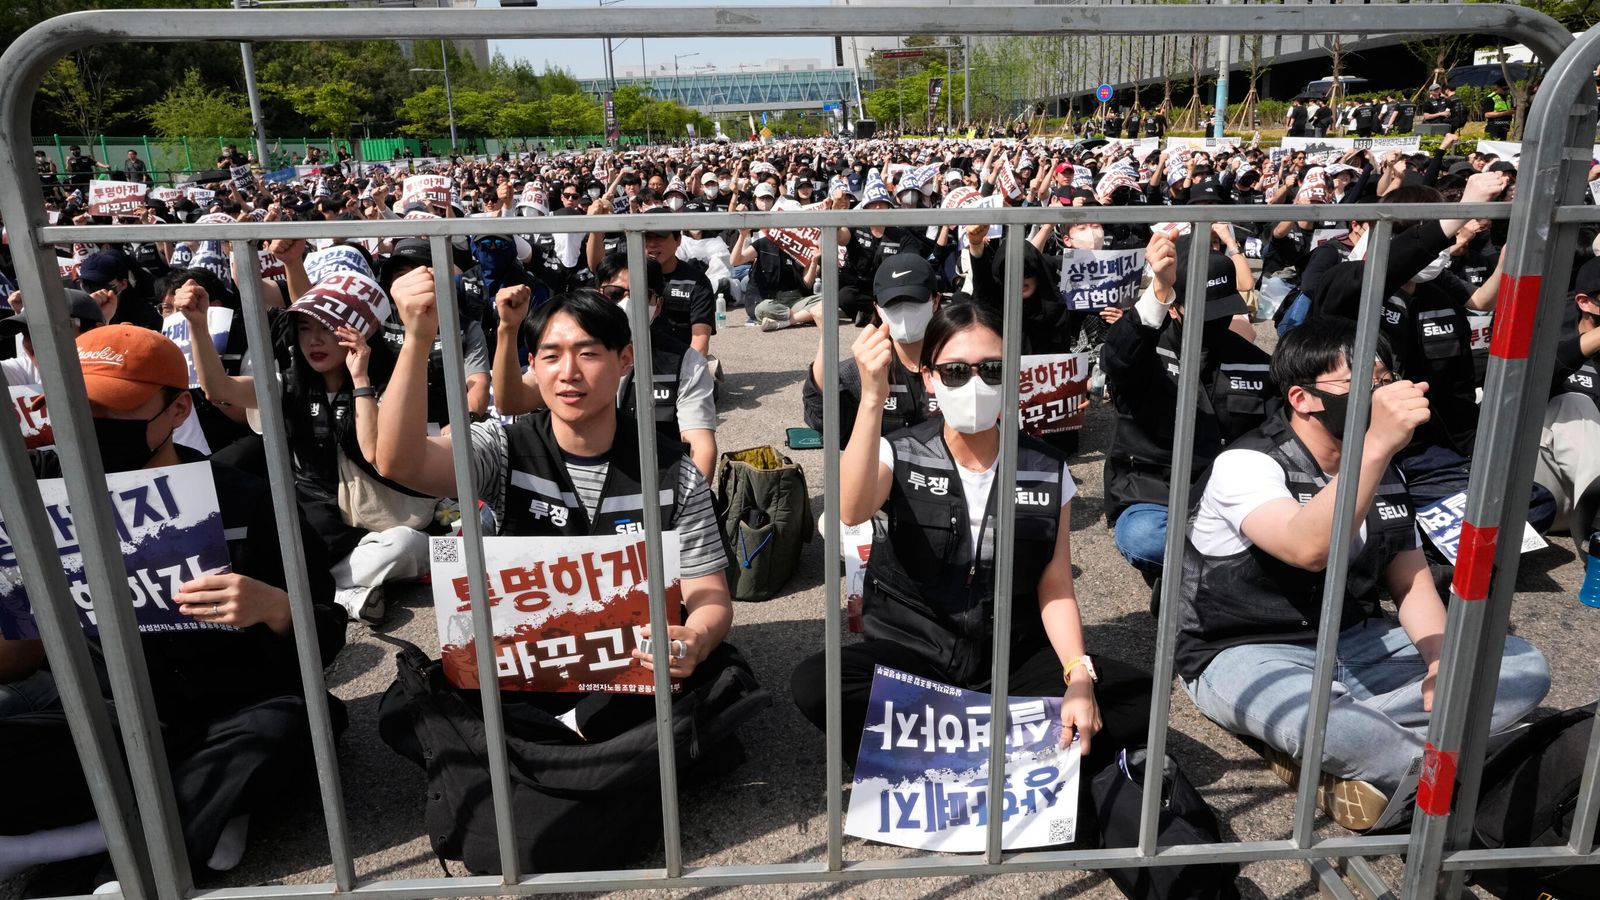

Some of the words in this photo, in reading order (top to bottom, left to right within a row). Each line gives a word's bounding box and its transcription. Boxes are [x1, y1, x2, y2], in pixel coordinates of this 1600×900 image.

[1354, 139, 1373, 150] NSEU
[93, 184, 139, 198] 투명하게
[1067, 252, 1138, 283] 상한폐지
[1207, 275, 1229, 288] SEU
[671, 289, 690, 298] SELU
[1072, 281, 1140, 310] 실현하자
[1423, 323, 1455, 337] SELU
[77, 346, 129, 363] nockin'
[1019, 356, 1079, 394] 명하게
[1230, 379, 1263, 390] SELU
[653, 389, 670, 399] LU
[907, 470, 950, 495] 투쟁
[528, 499, 569, 527] 투쟁
[1378, 503, 1409, 520] SELU
[615, 521, 645, 535] SEL
[451, 540, 649, 613] 투명하게
[577, 683, 637, 693] 삼성전자노동조합
[863, 699, 1053, 754] 실현하자
[877, 765, 1067, 833] 상한폐지
